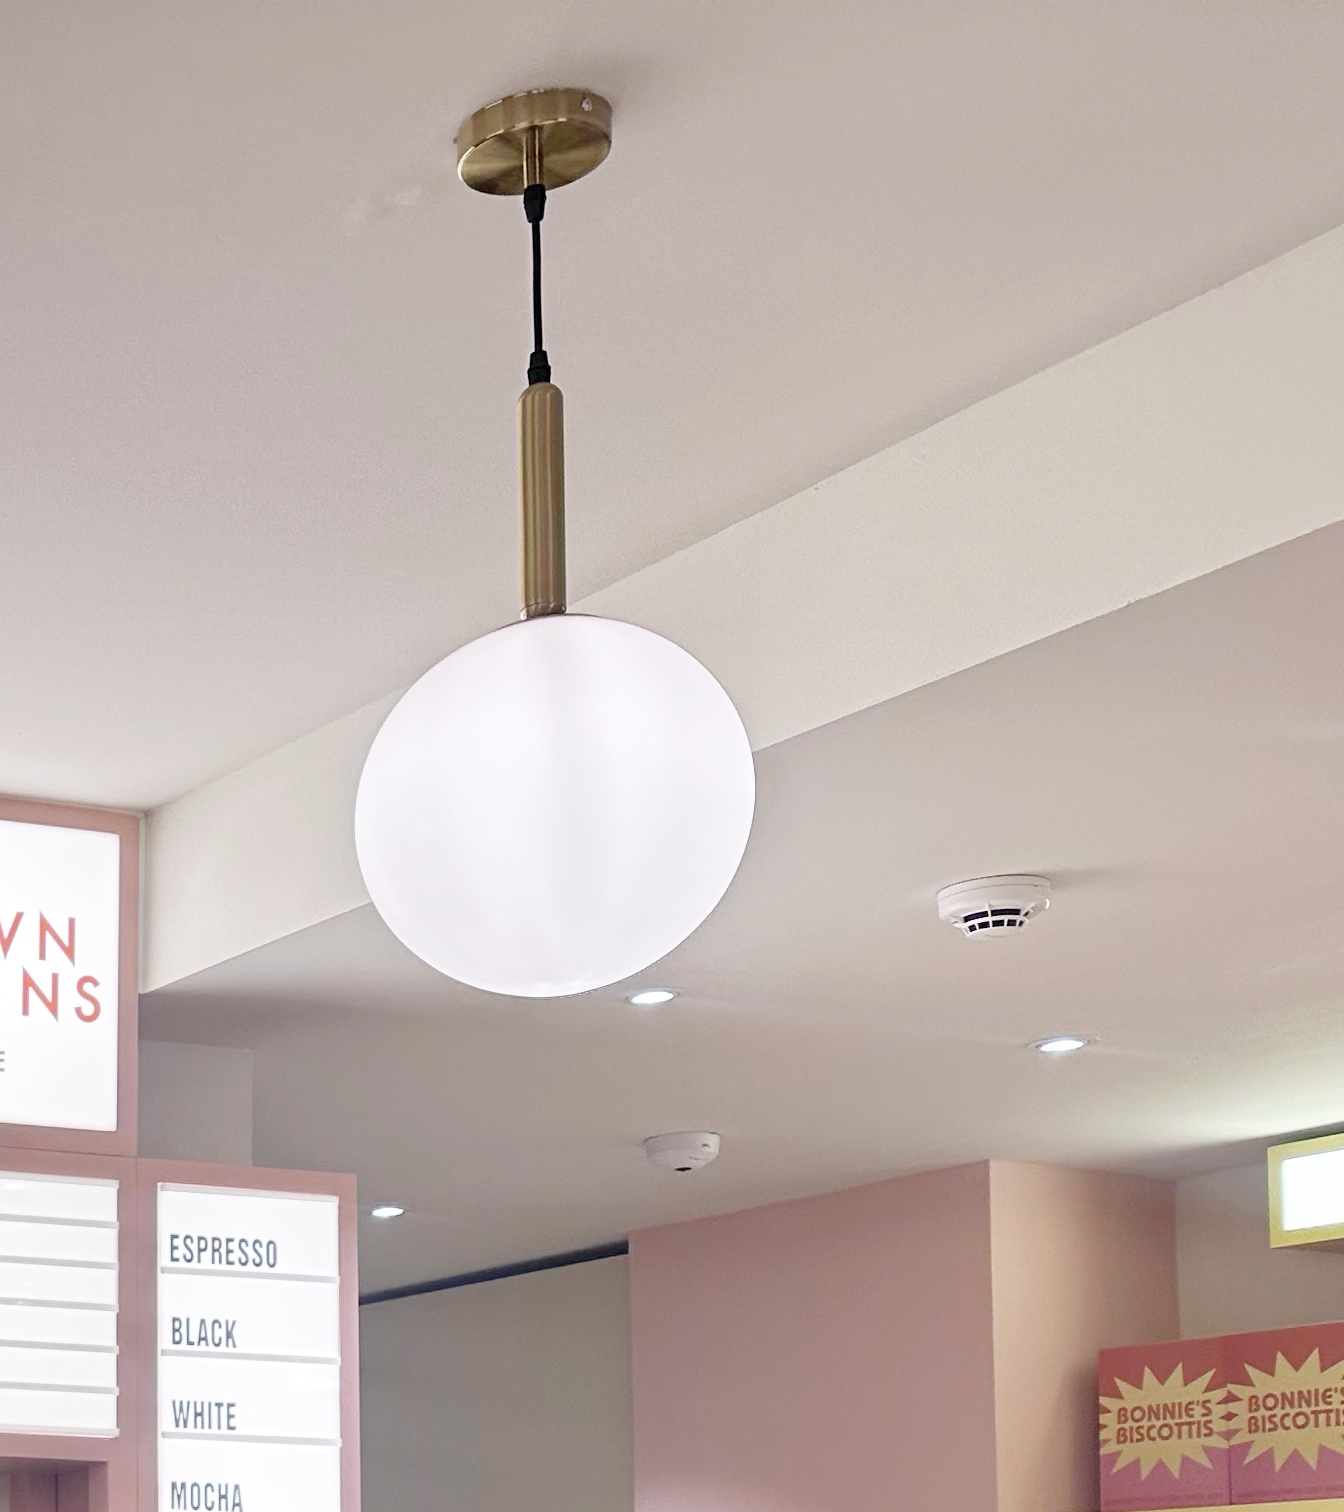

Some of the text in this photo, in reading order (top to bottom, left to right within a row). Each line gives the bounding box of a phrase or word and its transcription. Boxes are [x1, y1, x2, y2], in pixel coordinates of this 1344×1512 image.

[169, 1234, 278, 1268] ESPRESSO
[171, 1317, 237, 1349] BLACK
[172, 1399, 237, 1431] WHITE
[1116, 1399, 1212, 1425] BONNIE'S
[1248, 1408, 1344, 1434] BISCOTTI
[1115, 1419, 1214, 1445] BISCOTTIS
[170, 1481, 244, 1512] MOCHA
